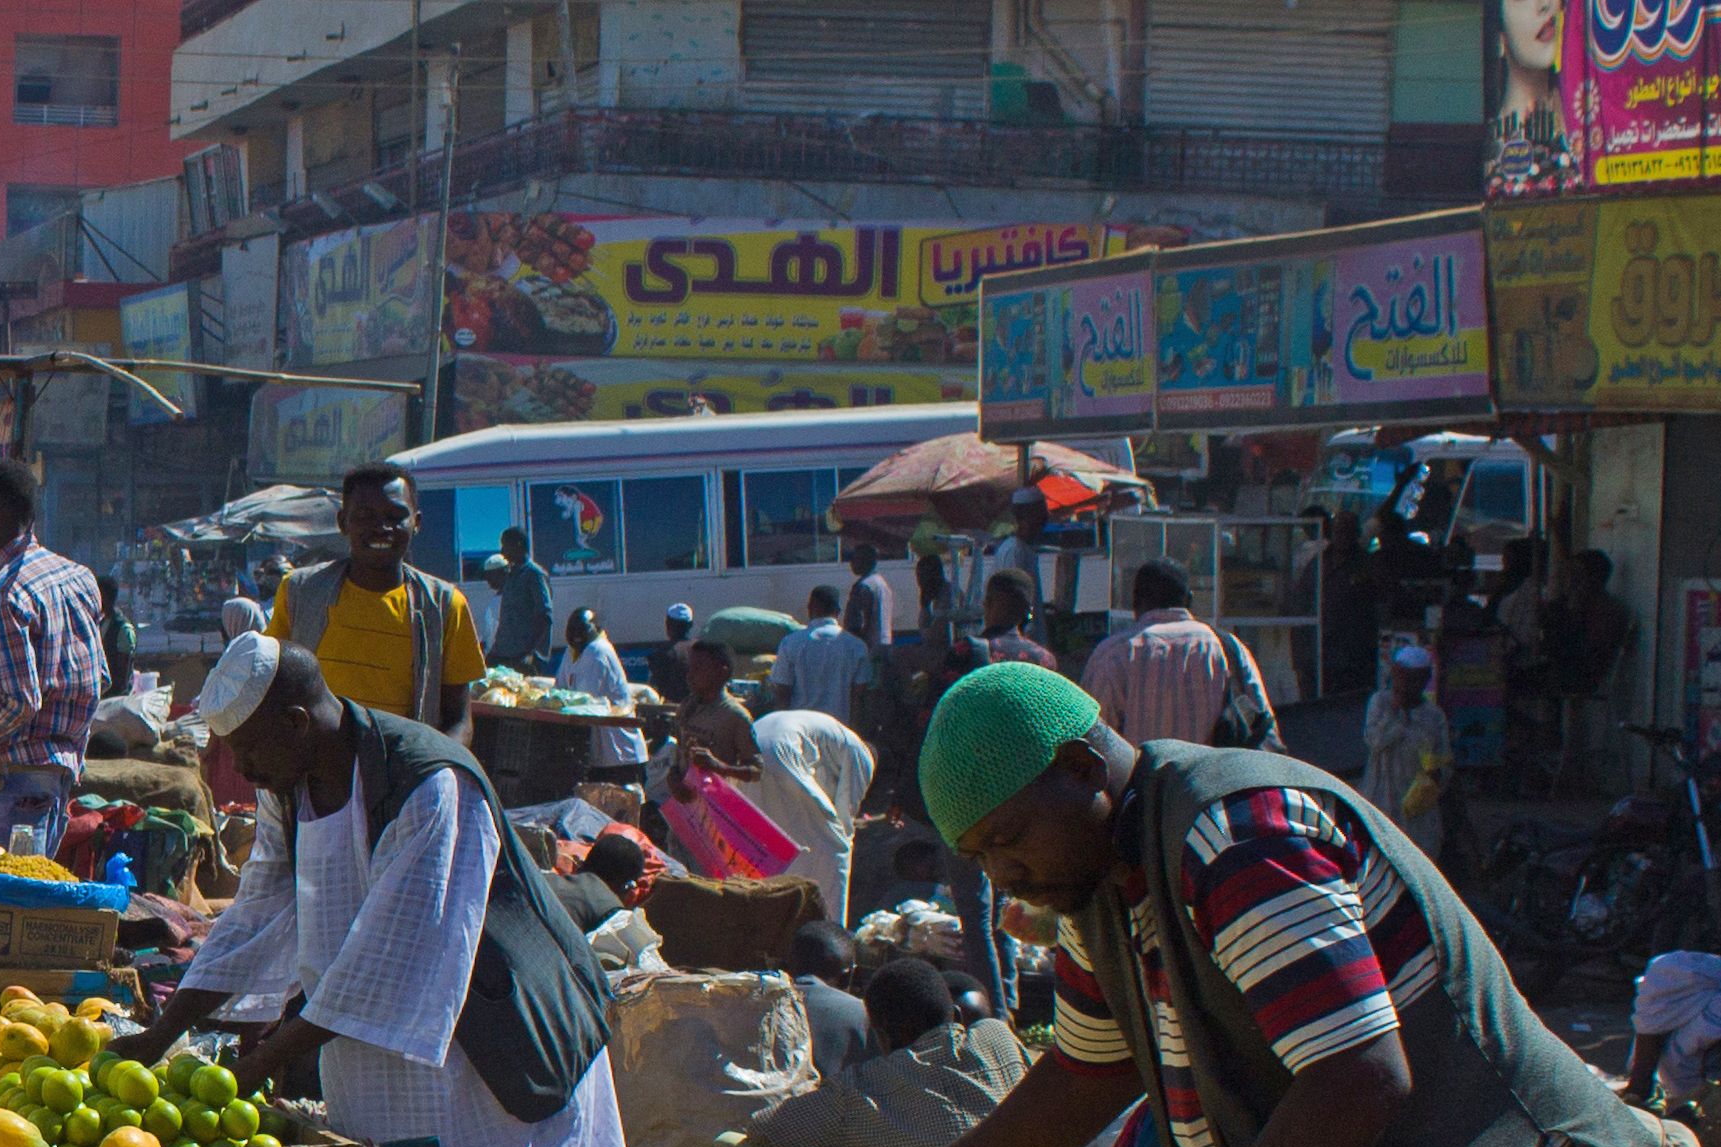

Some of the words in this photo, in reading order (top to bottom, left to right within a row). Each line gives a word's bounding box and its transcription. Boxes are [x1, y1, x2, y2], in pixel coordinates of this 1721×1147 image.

[1625, 75, 1666, 109] العطور
[1607, 121, 1640, 153] تجميل
[1640, 115, 1701, 148] مستحضرات
[624, 226, 901, 304] الهدى
[932, 226, 1090, 296] كافتيريا
[1610, 219, 1721, 348] روق
[1080, 288, 1143, 397] الفتح
[1344, 253, 1460, 382] الفتح
[25, 920, 101, 936] HAEMODIALYSIS
[26, 931, 96, 945] CONCENTRATE
